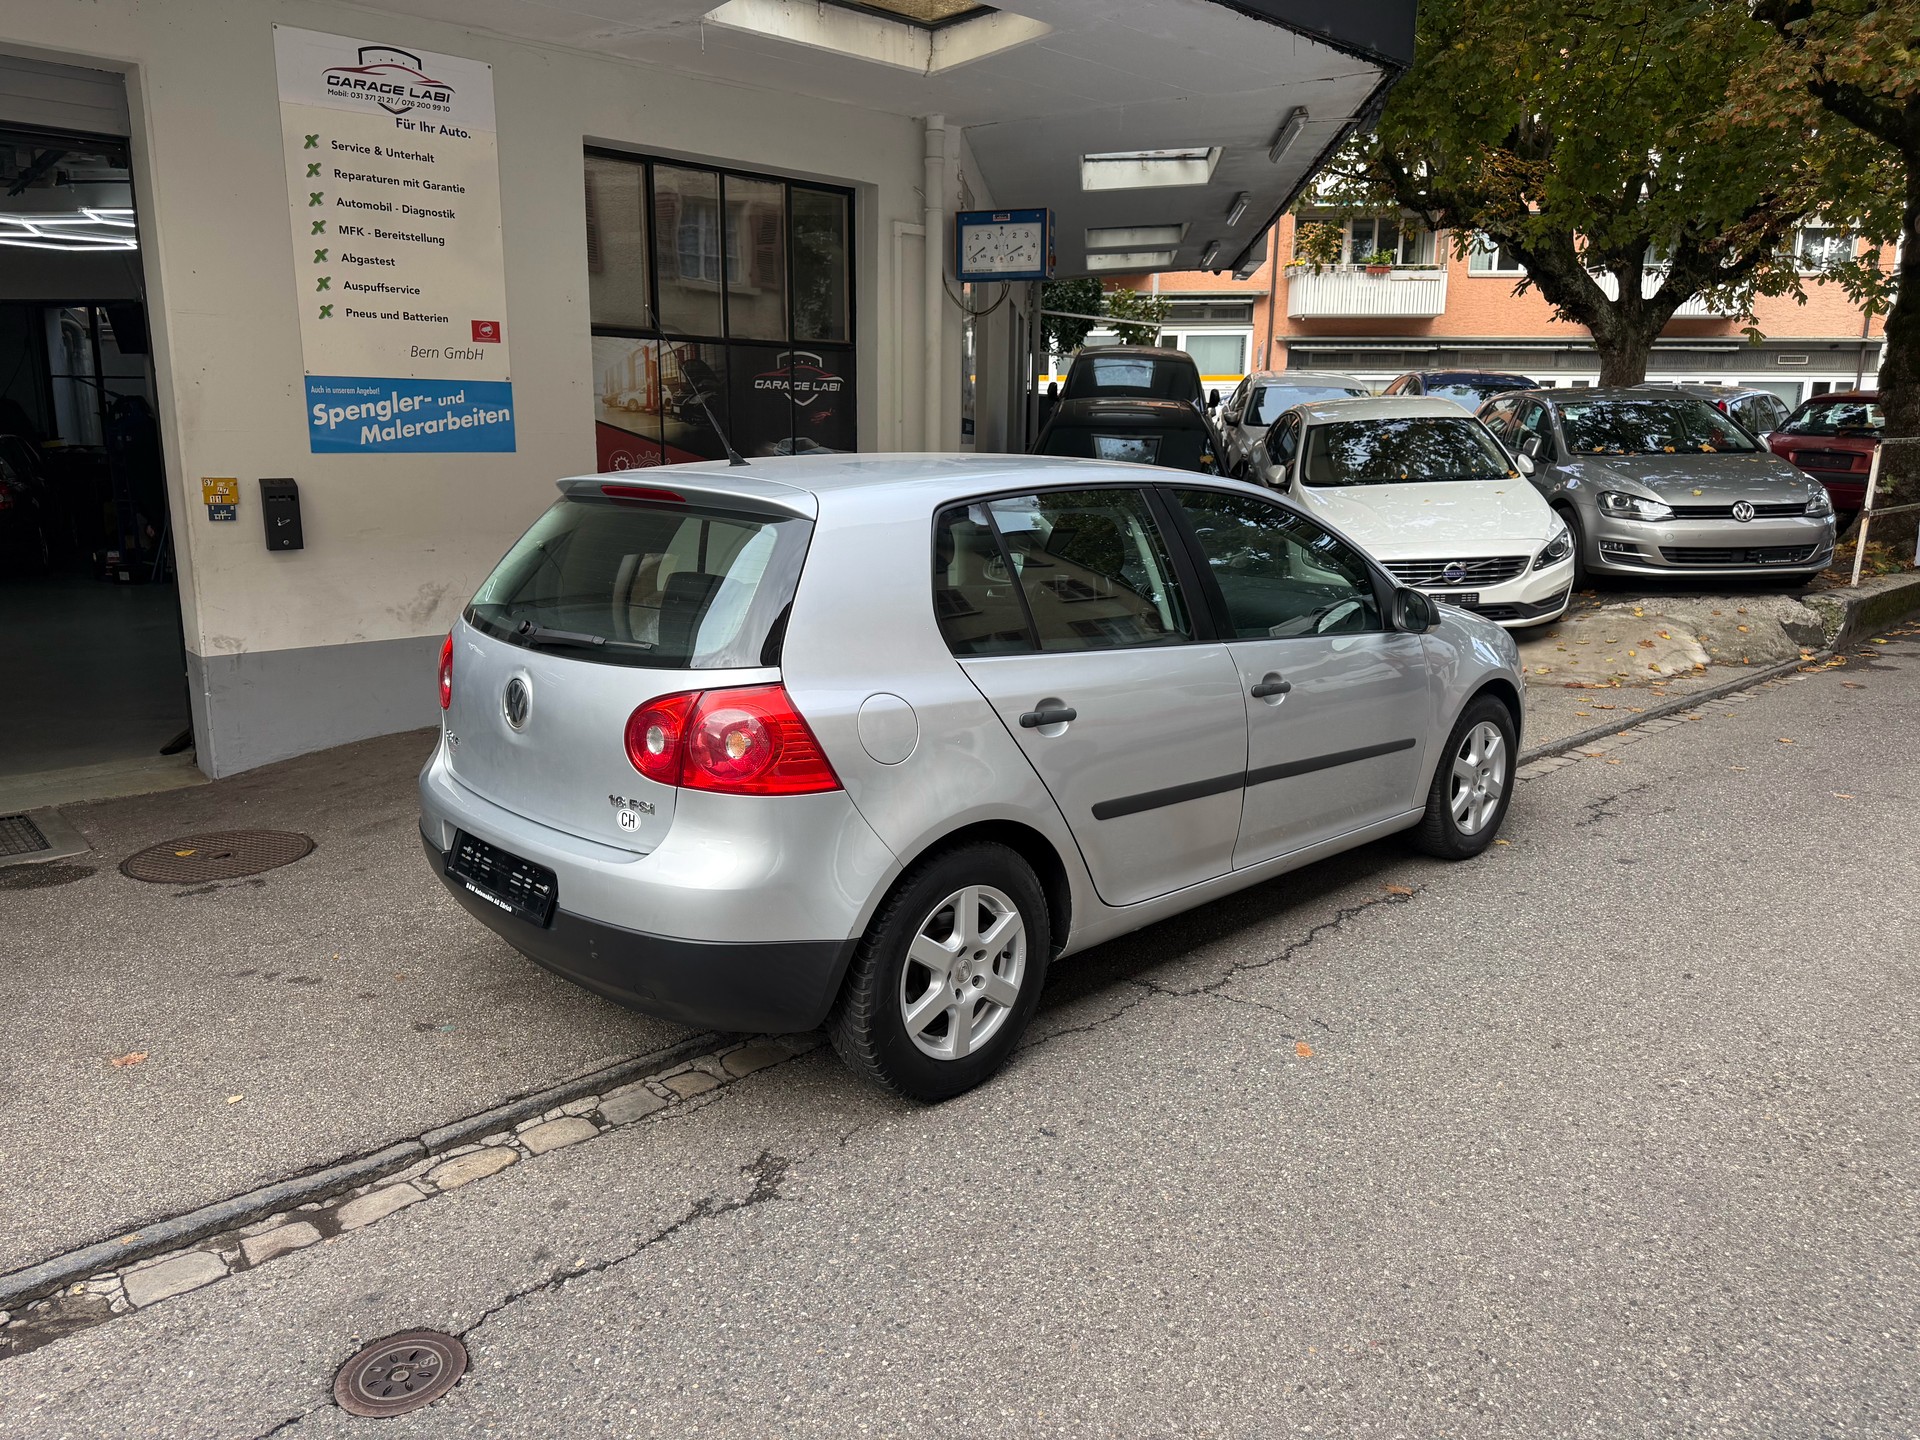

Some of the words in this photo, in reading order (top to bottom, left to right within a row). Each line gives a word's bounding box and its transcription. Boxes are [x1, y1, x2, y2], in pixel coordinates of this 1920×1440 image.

[327, 75, 405, 96] GARAGE
[410, 88, 451, 103] LABI
[328, 88, 349, 98] Mobil:
[365, 93, 376, 101] 371
[386, 96, 394, 104] 21
[417, 102, 431, 110] 200
[442, 105, 451, 113] 10
[396, 118, 416, 131] Für
[420, 120, 436, 134] Ihr
[439, 124, 472, 140] Auto.
[331, 140, 371, 155] Service
[374, 146, 383, 156] &
[386, 147, 435, 163] Unterhalt
[334, 168, 400, 186] Reparaturen
[403, 177, 420, 189] mit
[422, 180, 466, 194] Garantie
[336, 197, 392, 212] Automobil
[402, 204, 456, 219] Diagnostik
[338, 225, 365, 237] MFK
[374, 229, 446, 247] Bereitstellung
[341, 253, 396, 267] Abgastest
[344, 281, 421, 295] Auspuffservice
[346, 308, 378, 319] Pneus
[380, 311, 400, 320] und
[403, 312, 449, 324] Batterien
[410, 345, 439, 359] Bern
[444, 347, 484, 361] GmbH
[311, 386, 325, 394] Auch
[326, 386, 332, 394] in
[356, 386, 380, 396] Angebot!
[813, 382, 841, 392] LABI
[313, 391, 432, 430] Spengler-
[438, 390, 465, 407] und
[360, 407, 510, 445] Malerarbeiten
[622, 812, 635, 829] CH
